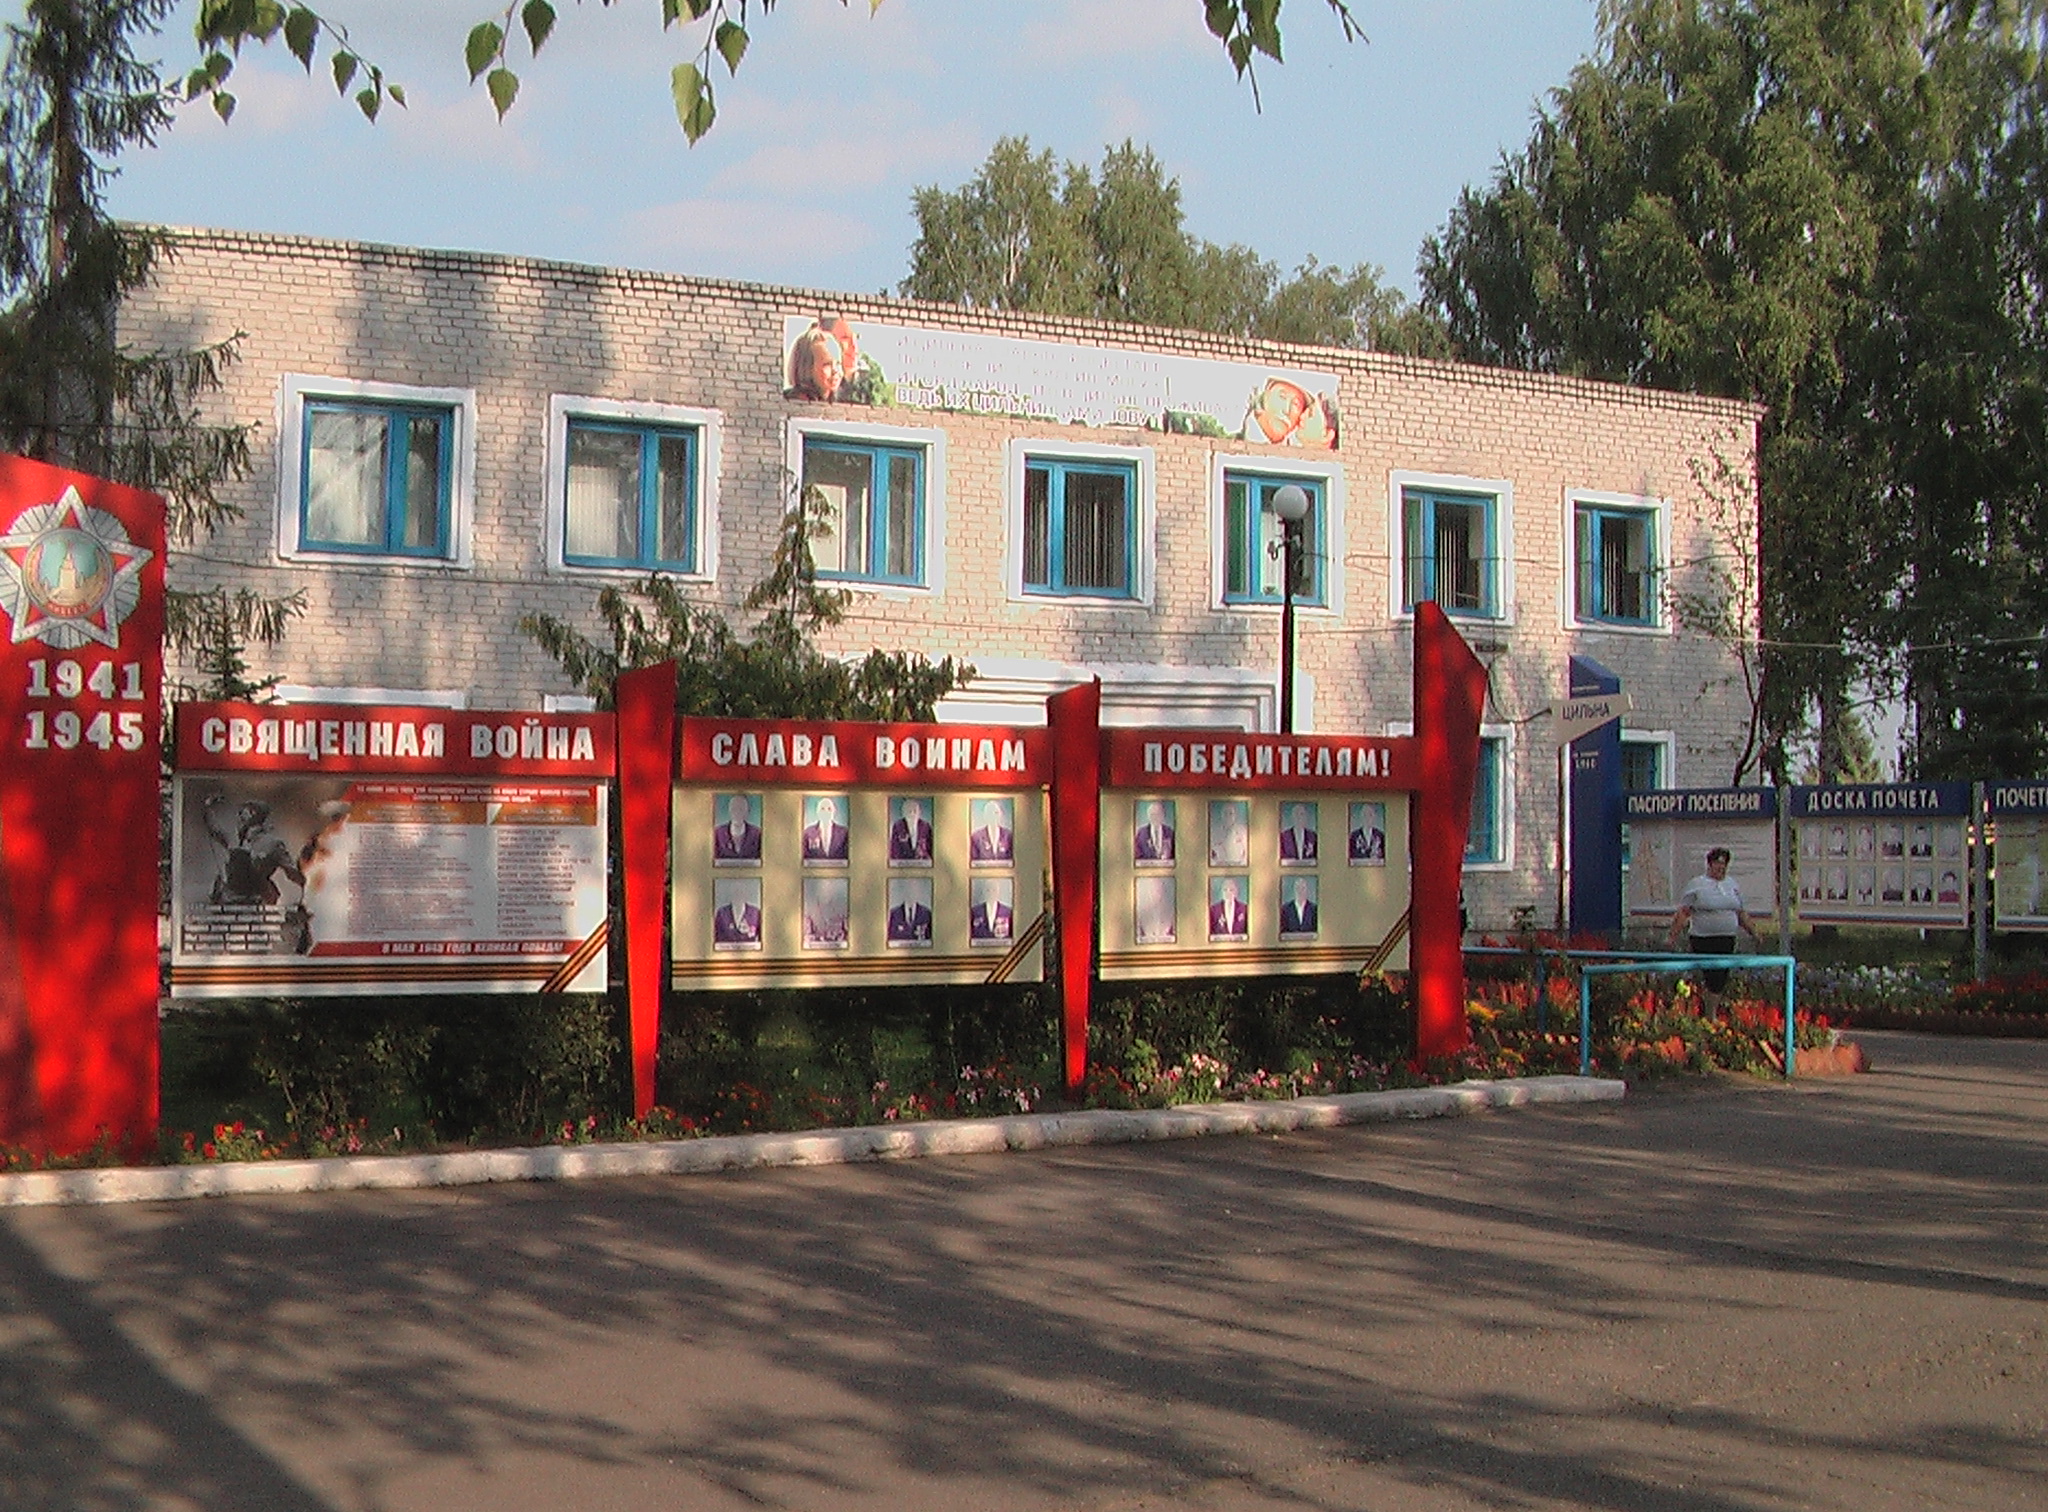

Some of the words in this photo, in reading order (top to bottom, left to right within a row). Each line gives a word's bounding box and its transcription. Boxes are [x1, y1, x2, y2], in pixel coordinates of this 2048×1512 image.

[27, 659, 144, 699] 1941
[26, 710, 144, 751] 1945
[1562, 702, 1610, 721] ЦИЛЬНА
[202, 717, 445, 761] СВЯЩЕННАЯ
[470, 718, 596, 761] ВОЙНА
[711, 732, 841, 767] СЛАВА
[875, 736, 1026, 772] ВОИНАМ
[1143, 742, 1392, 779] ПОБЕДИТЕЛЯМ!
[1628, 794, 1683, 814] ПАСПОРТ
[1688, 793, 1761, 812] ПОСЕЛЕНИЯ
[1807, 791, 1866, 812] ДОСКА
[1872, 789, 1939, 809] ПОЧЕТА
